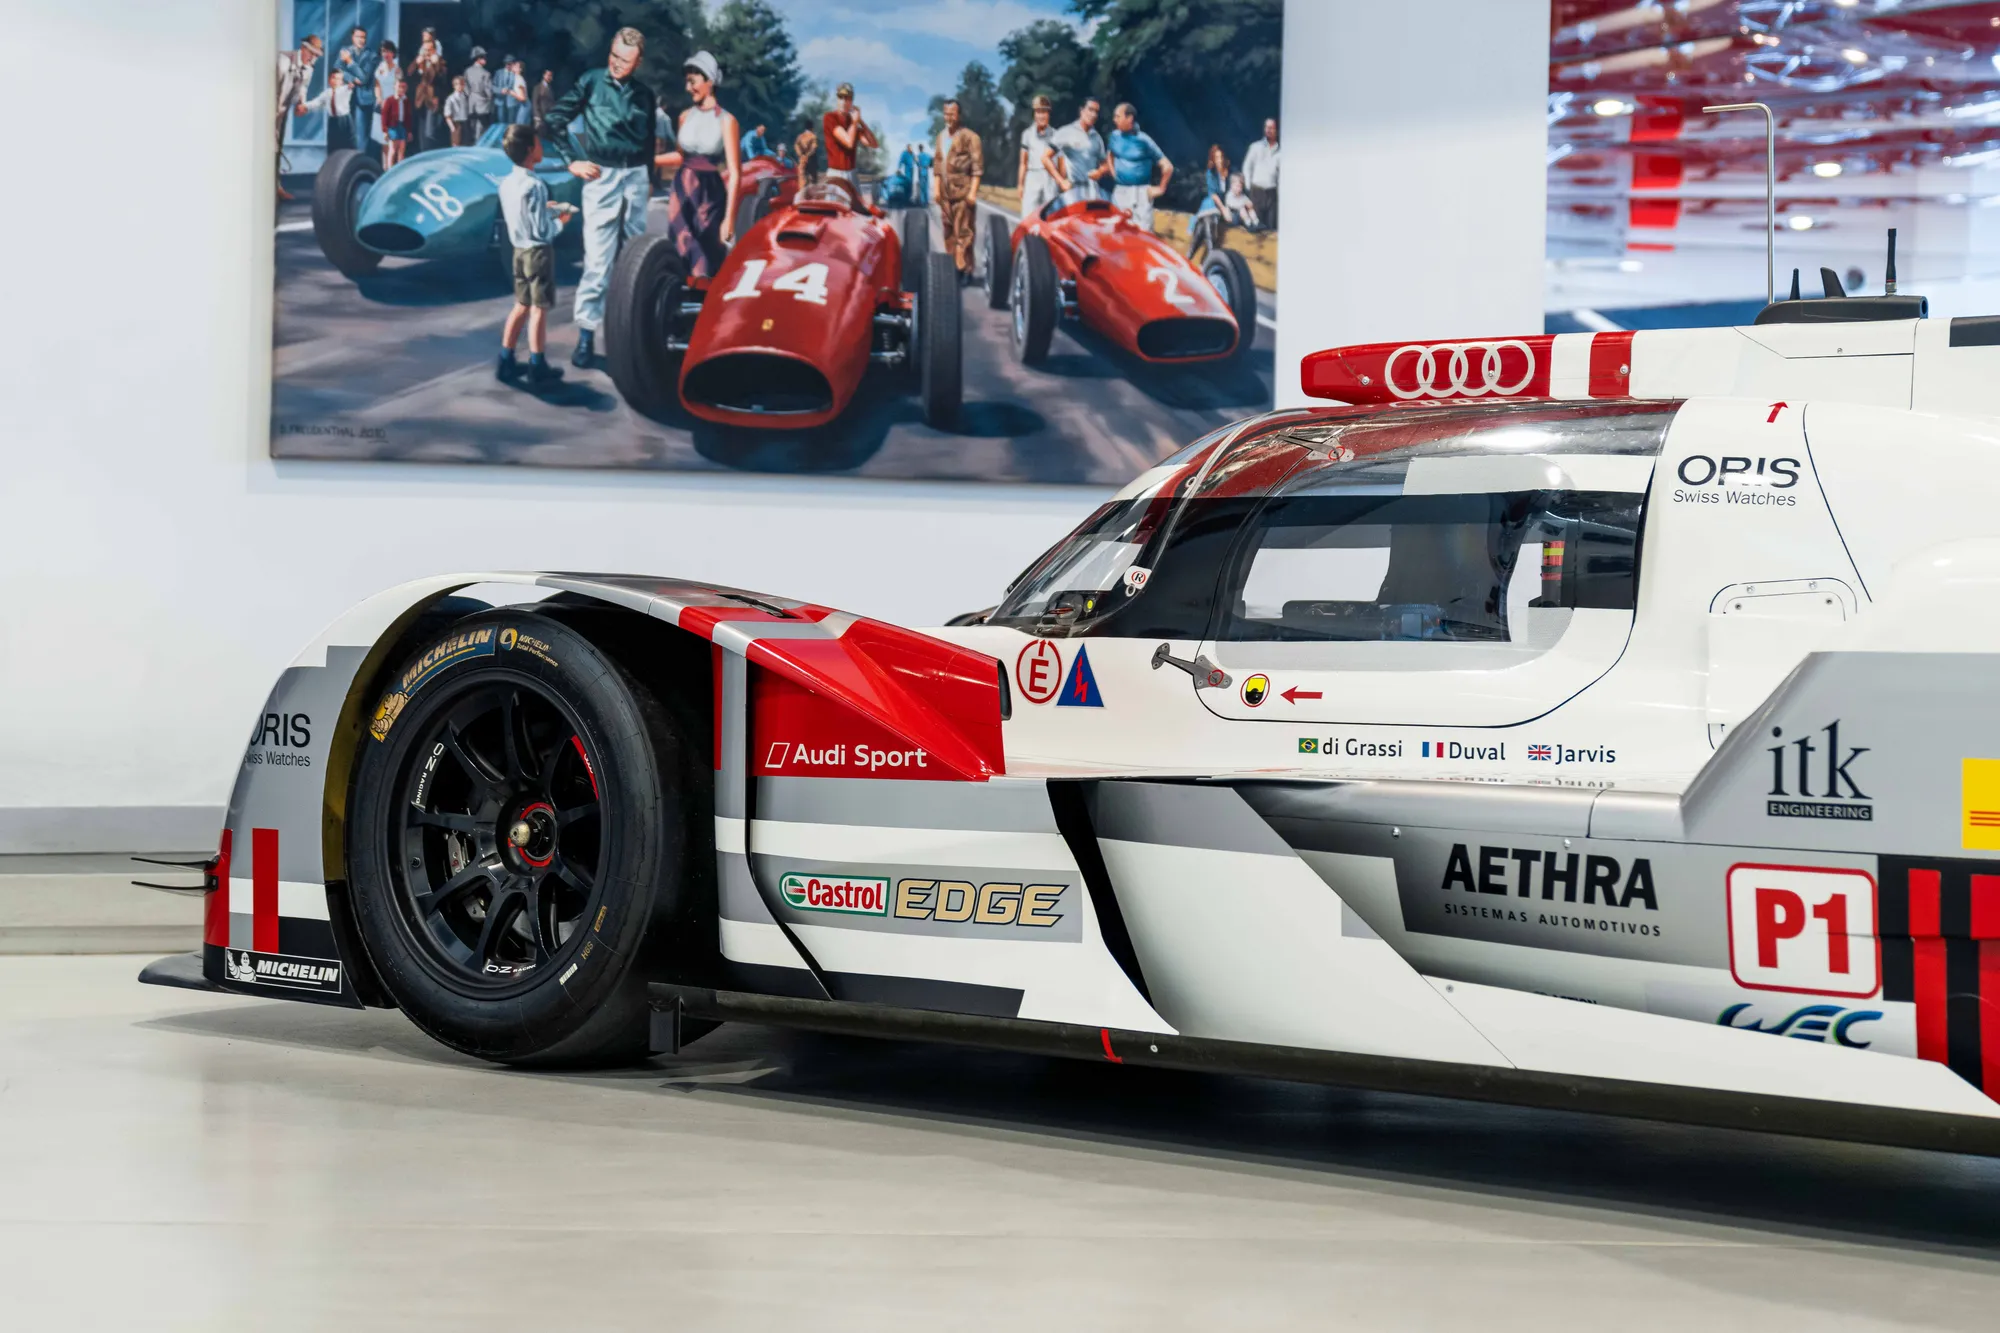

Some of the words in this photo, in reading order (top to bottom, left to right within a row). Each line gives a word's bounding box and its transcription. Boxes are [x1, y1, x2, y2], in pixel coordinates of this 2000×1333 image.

[722, 259, 829, 306] 14
[1147, 266, 1195, 304] 2
[1673, 489, 1720, 504] Swiss
[1726, 490, 1797, 507] Watches
[402, 628, 493, 689] MICHELIN
[519, 635, 551, 651] MICHELIN
[1028, 658, 1050, 694] E
[265, 750, 311, 767] Watches
[793, 743, 846, 766] Audi
[854, 744, 928, 772] Sport
[1322, 737, 1339, 755] di
[1345, 738, 1403, 758] Grassi
[1449, 741, 1506, 760] Duval
[1555, 743, 1616, 765] Jarvis
[1766, 718, 1874, 801] itk
[1769, 802, 1870, 819] ENGINEERING
[1441, 843, 1659, 911] AETHRA
[807, 878, 883, 910] Castrol
[893, 877, 1071, 928] EDGE
[1445, 903, 1528, 923] SISTEMAS
[1538, 913, 1661, 937] AUTOMOTIVOS
[1755, 887, 1850, 974] P1
[256, 959, 339, 982] MICHELIN
[1716, 1002, 1884, 1050] WEC
